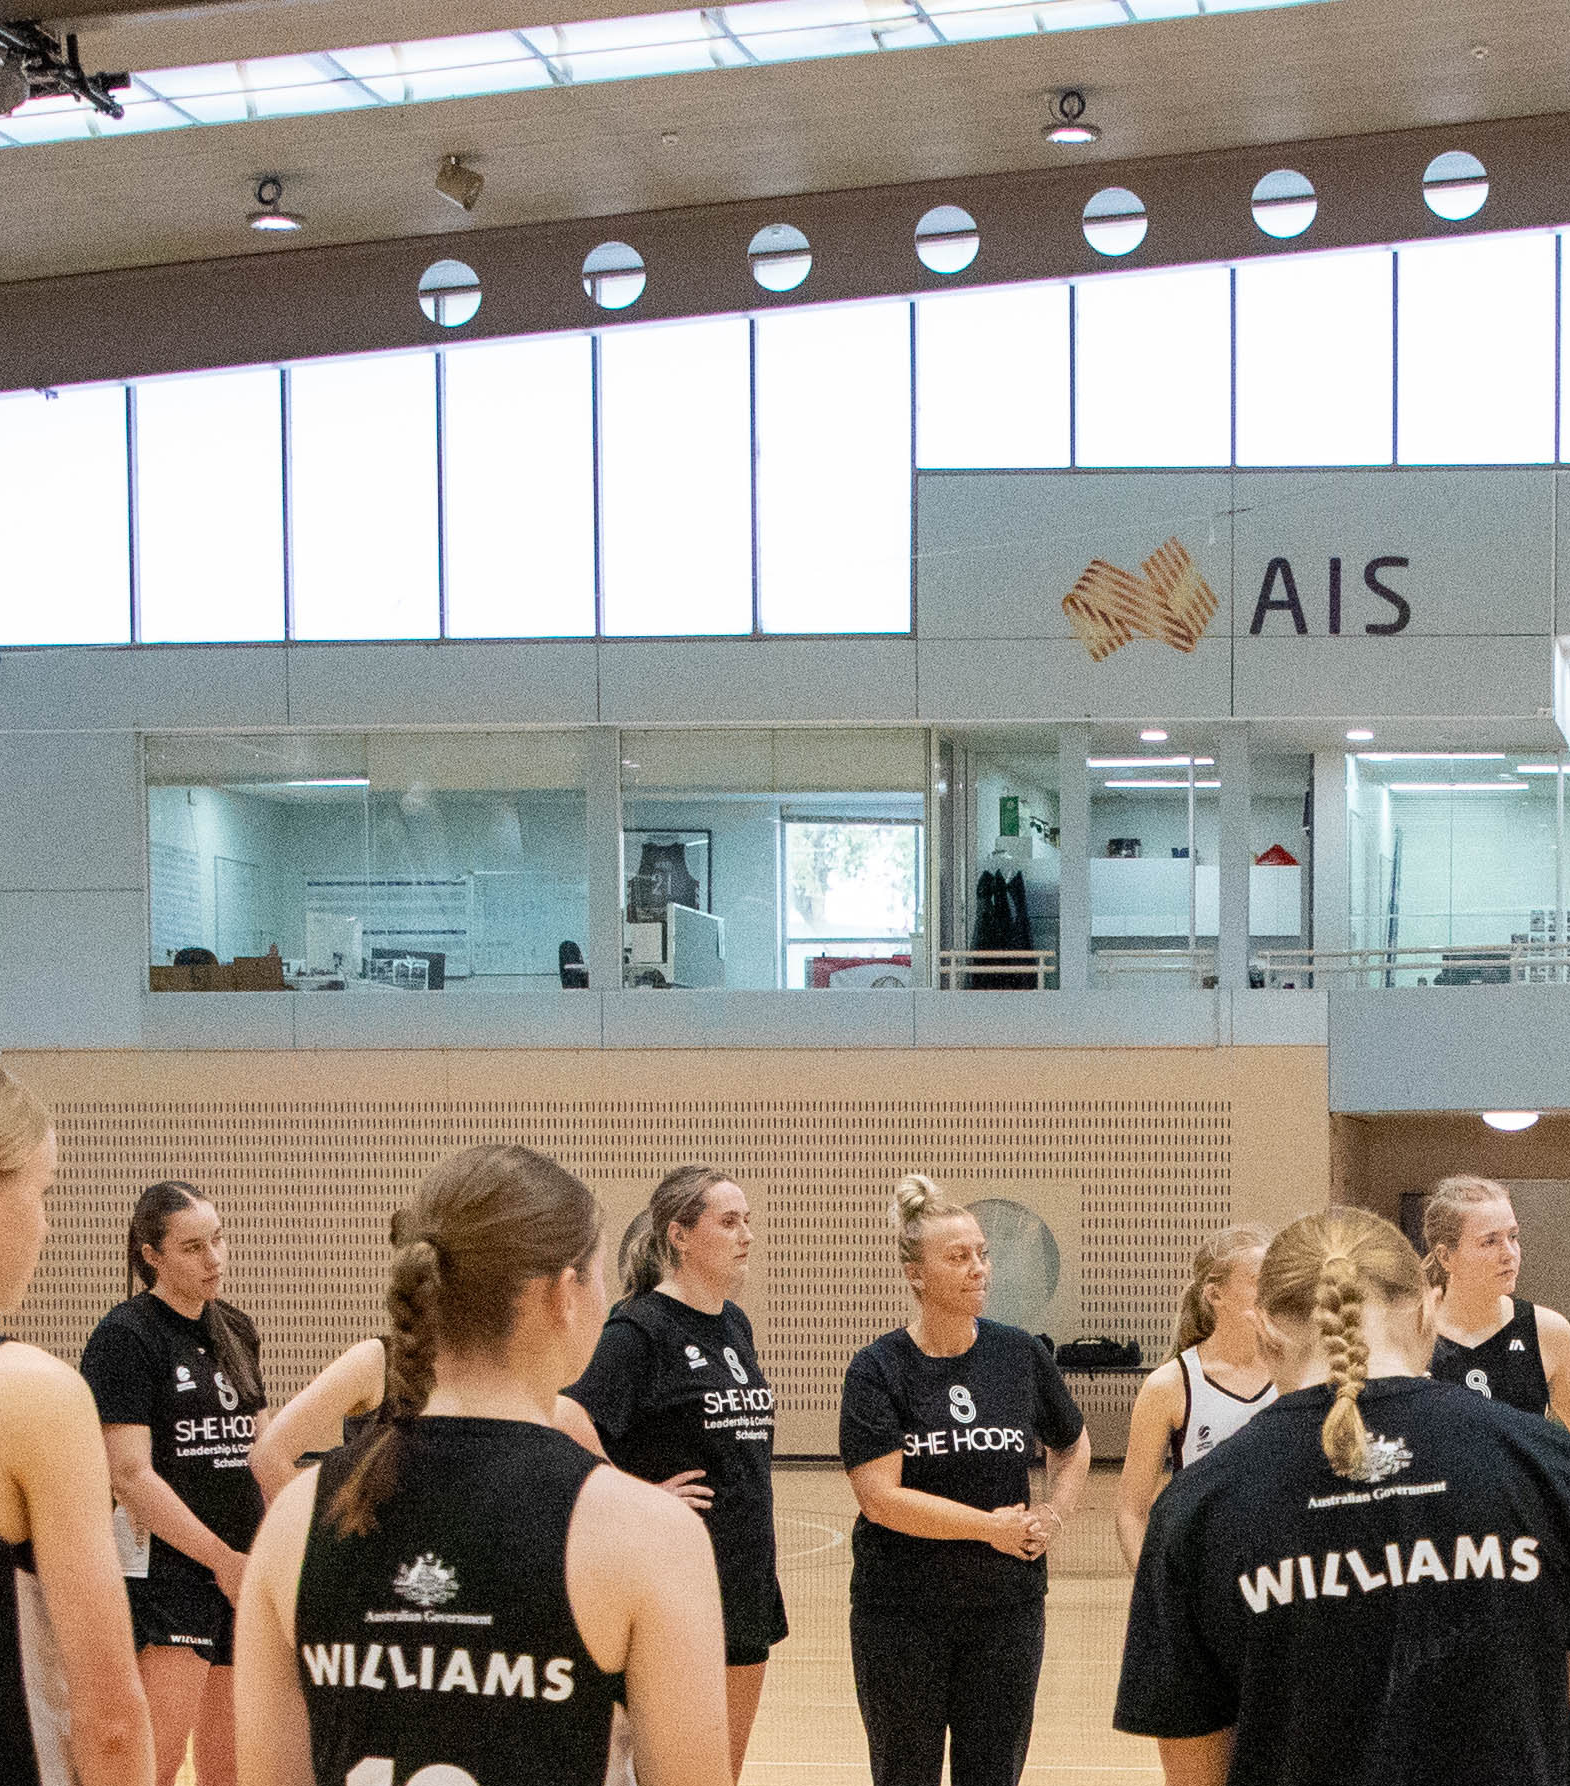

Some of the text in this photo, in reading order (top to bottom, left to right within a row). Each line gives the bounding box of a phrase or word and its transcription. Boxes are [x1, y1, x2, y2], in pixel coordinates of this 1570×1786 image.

[1249, 555, 1413, 637] AIS
[703, 1389, 743, 1414] SHE
[174, 1415, 256, 1442] SHE HOO
[903, 1426, 1025, 1457] SHE HOOPS
[176, 1443, 231, 1457] Leadership
[1308, 1480, 1447, 1509] Australian Government
[1237, 1533, 1541, 1615] WILLIAMS
[365, 1608, 493, 1625] Australian Government
[302, 1643, 576, 1702] WILLIAMS
